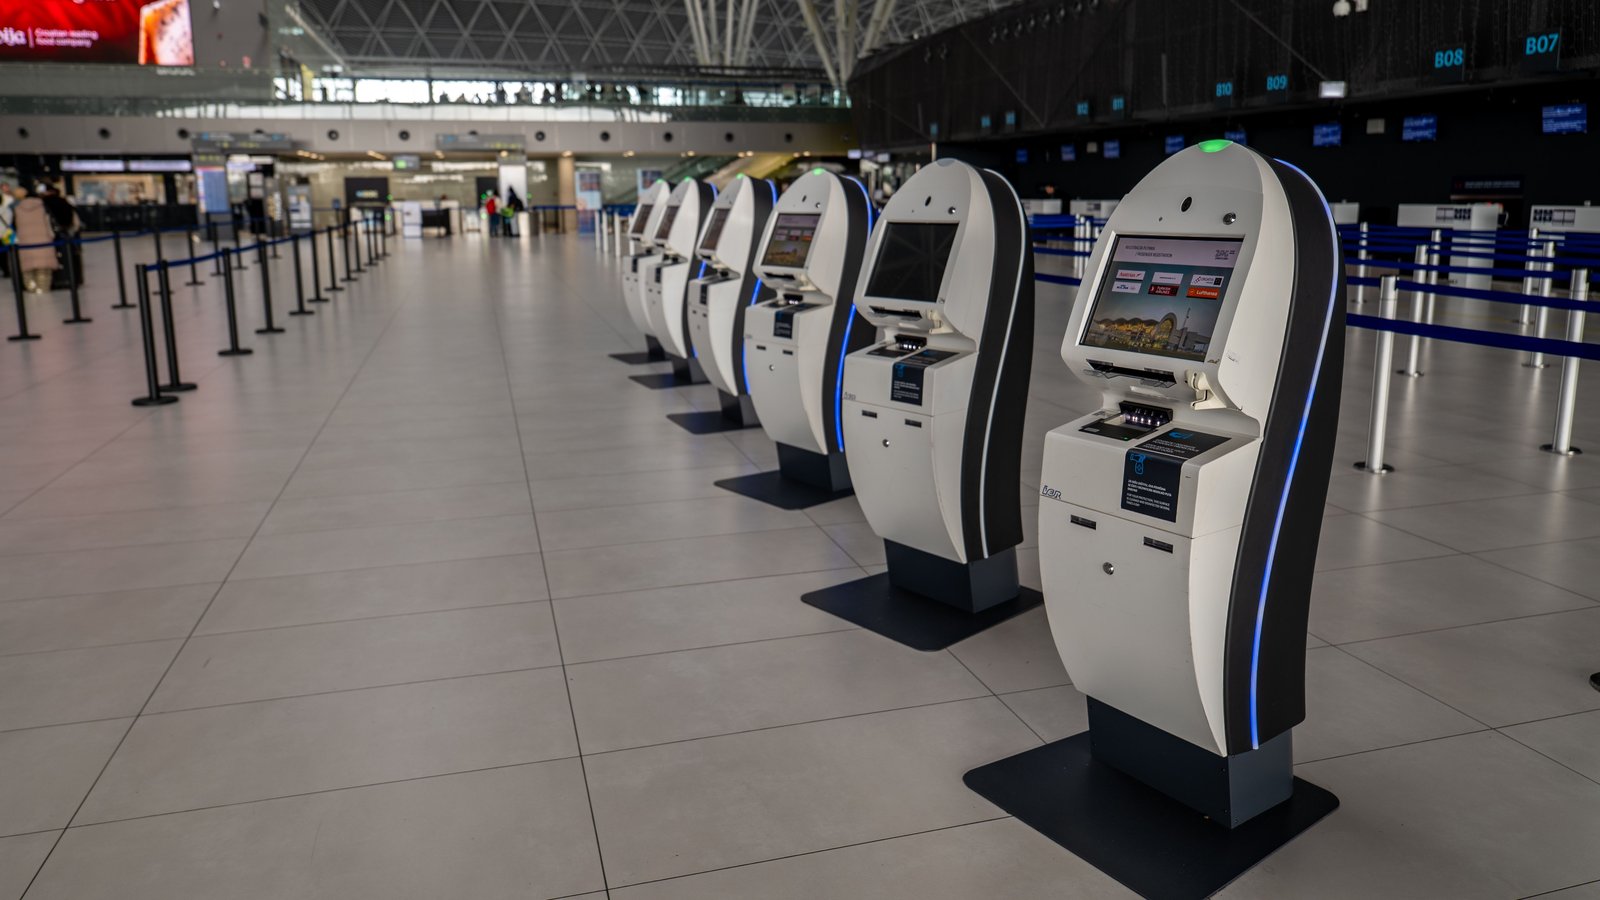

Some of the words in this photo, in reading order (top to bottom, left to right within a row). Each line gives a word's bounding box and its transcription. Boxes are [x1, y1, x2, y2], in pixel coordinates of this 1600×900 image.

[1525, 32, 1559, 56] B07
[1434, 48, 1464, 68] B08
[1215, 80, 1233, 97] B10
[1266, 74, 1288, 91] B09
